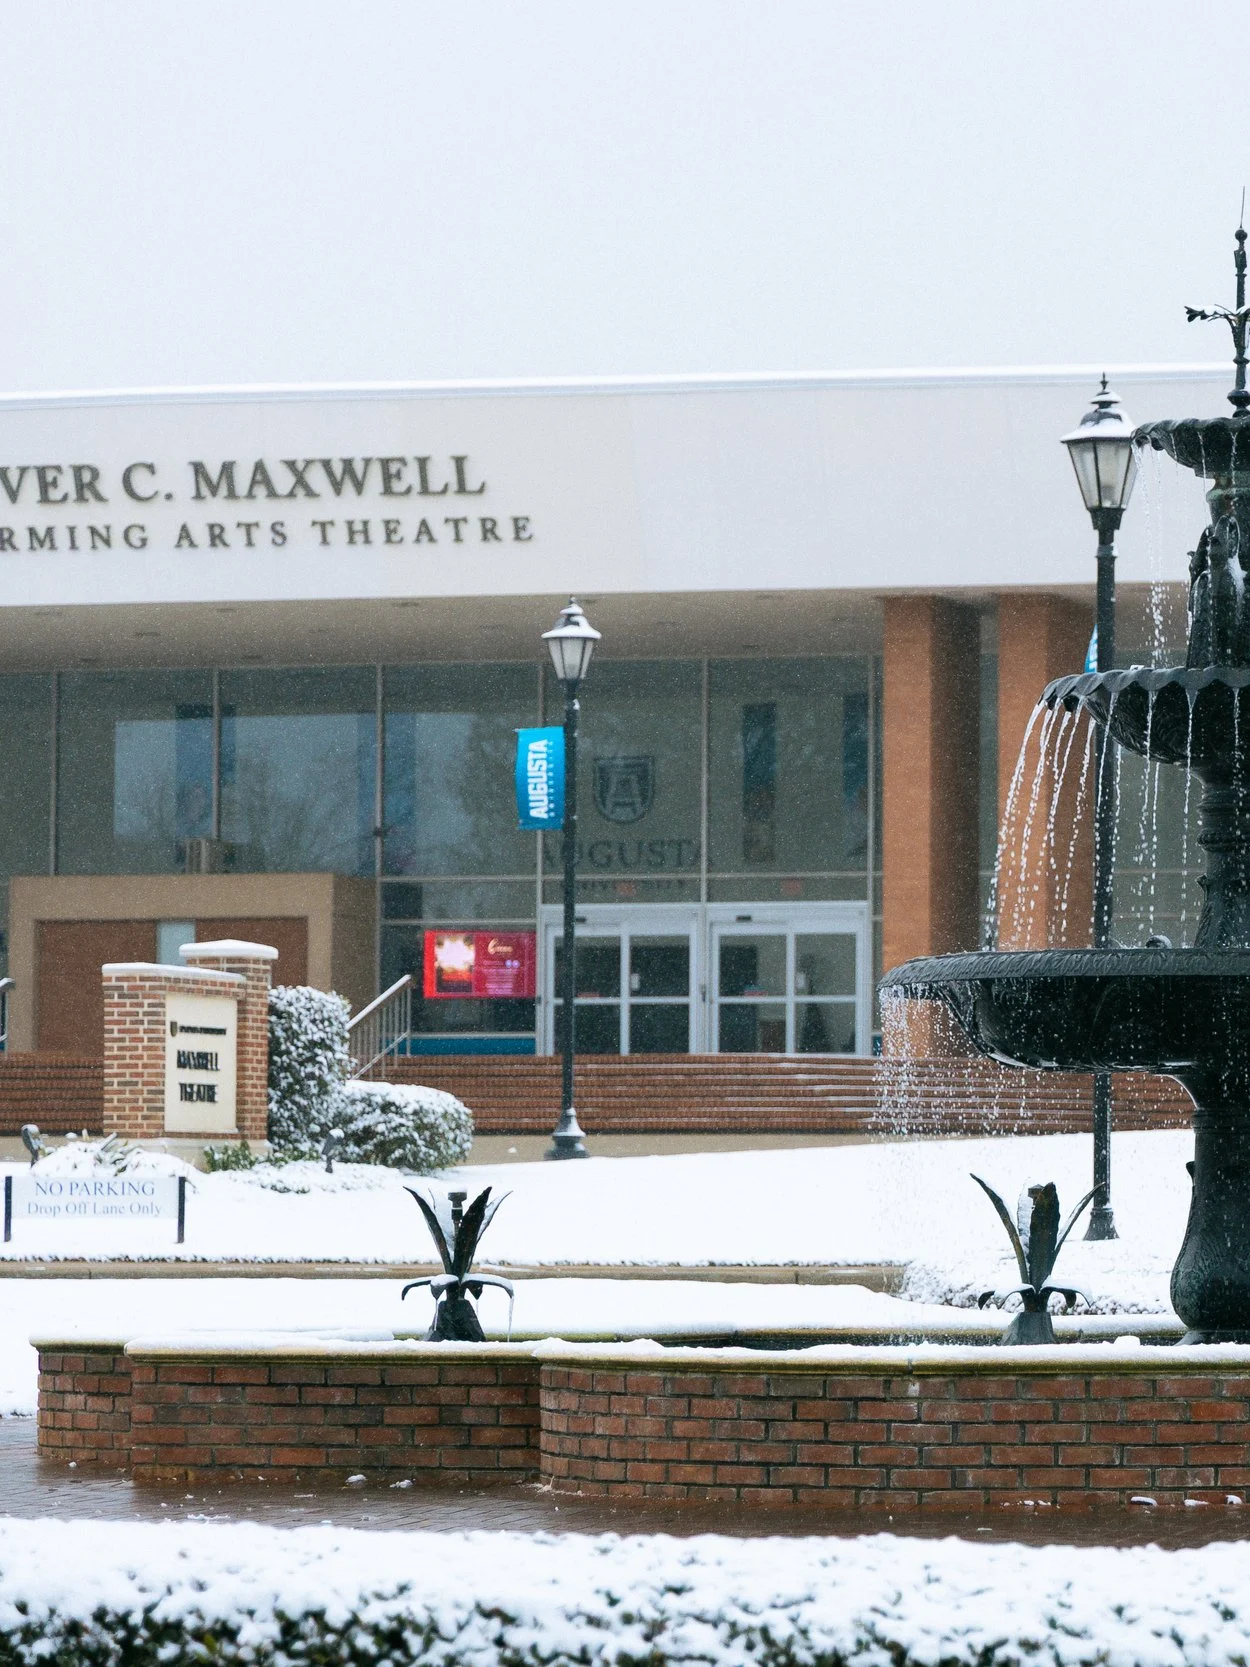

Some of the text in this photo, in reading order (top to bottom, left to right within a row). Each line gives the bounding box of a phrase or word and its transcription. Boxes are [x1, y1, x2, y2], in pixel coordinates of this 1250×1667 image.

[0, 455, 487, 504] VER C. MAXWELL
[0, 516, 535, 551] RMING ARTS THEATRE
[527, 739, 549, 819] AUGUSTA
[35, 1181, 155, 1196] NO PARKING
[28, 1202, 161, 1217] Drop Off Lane Only
